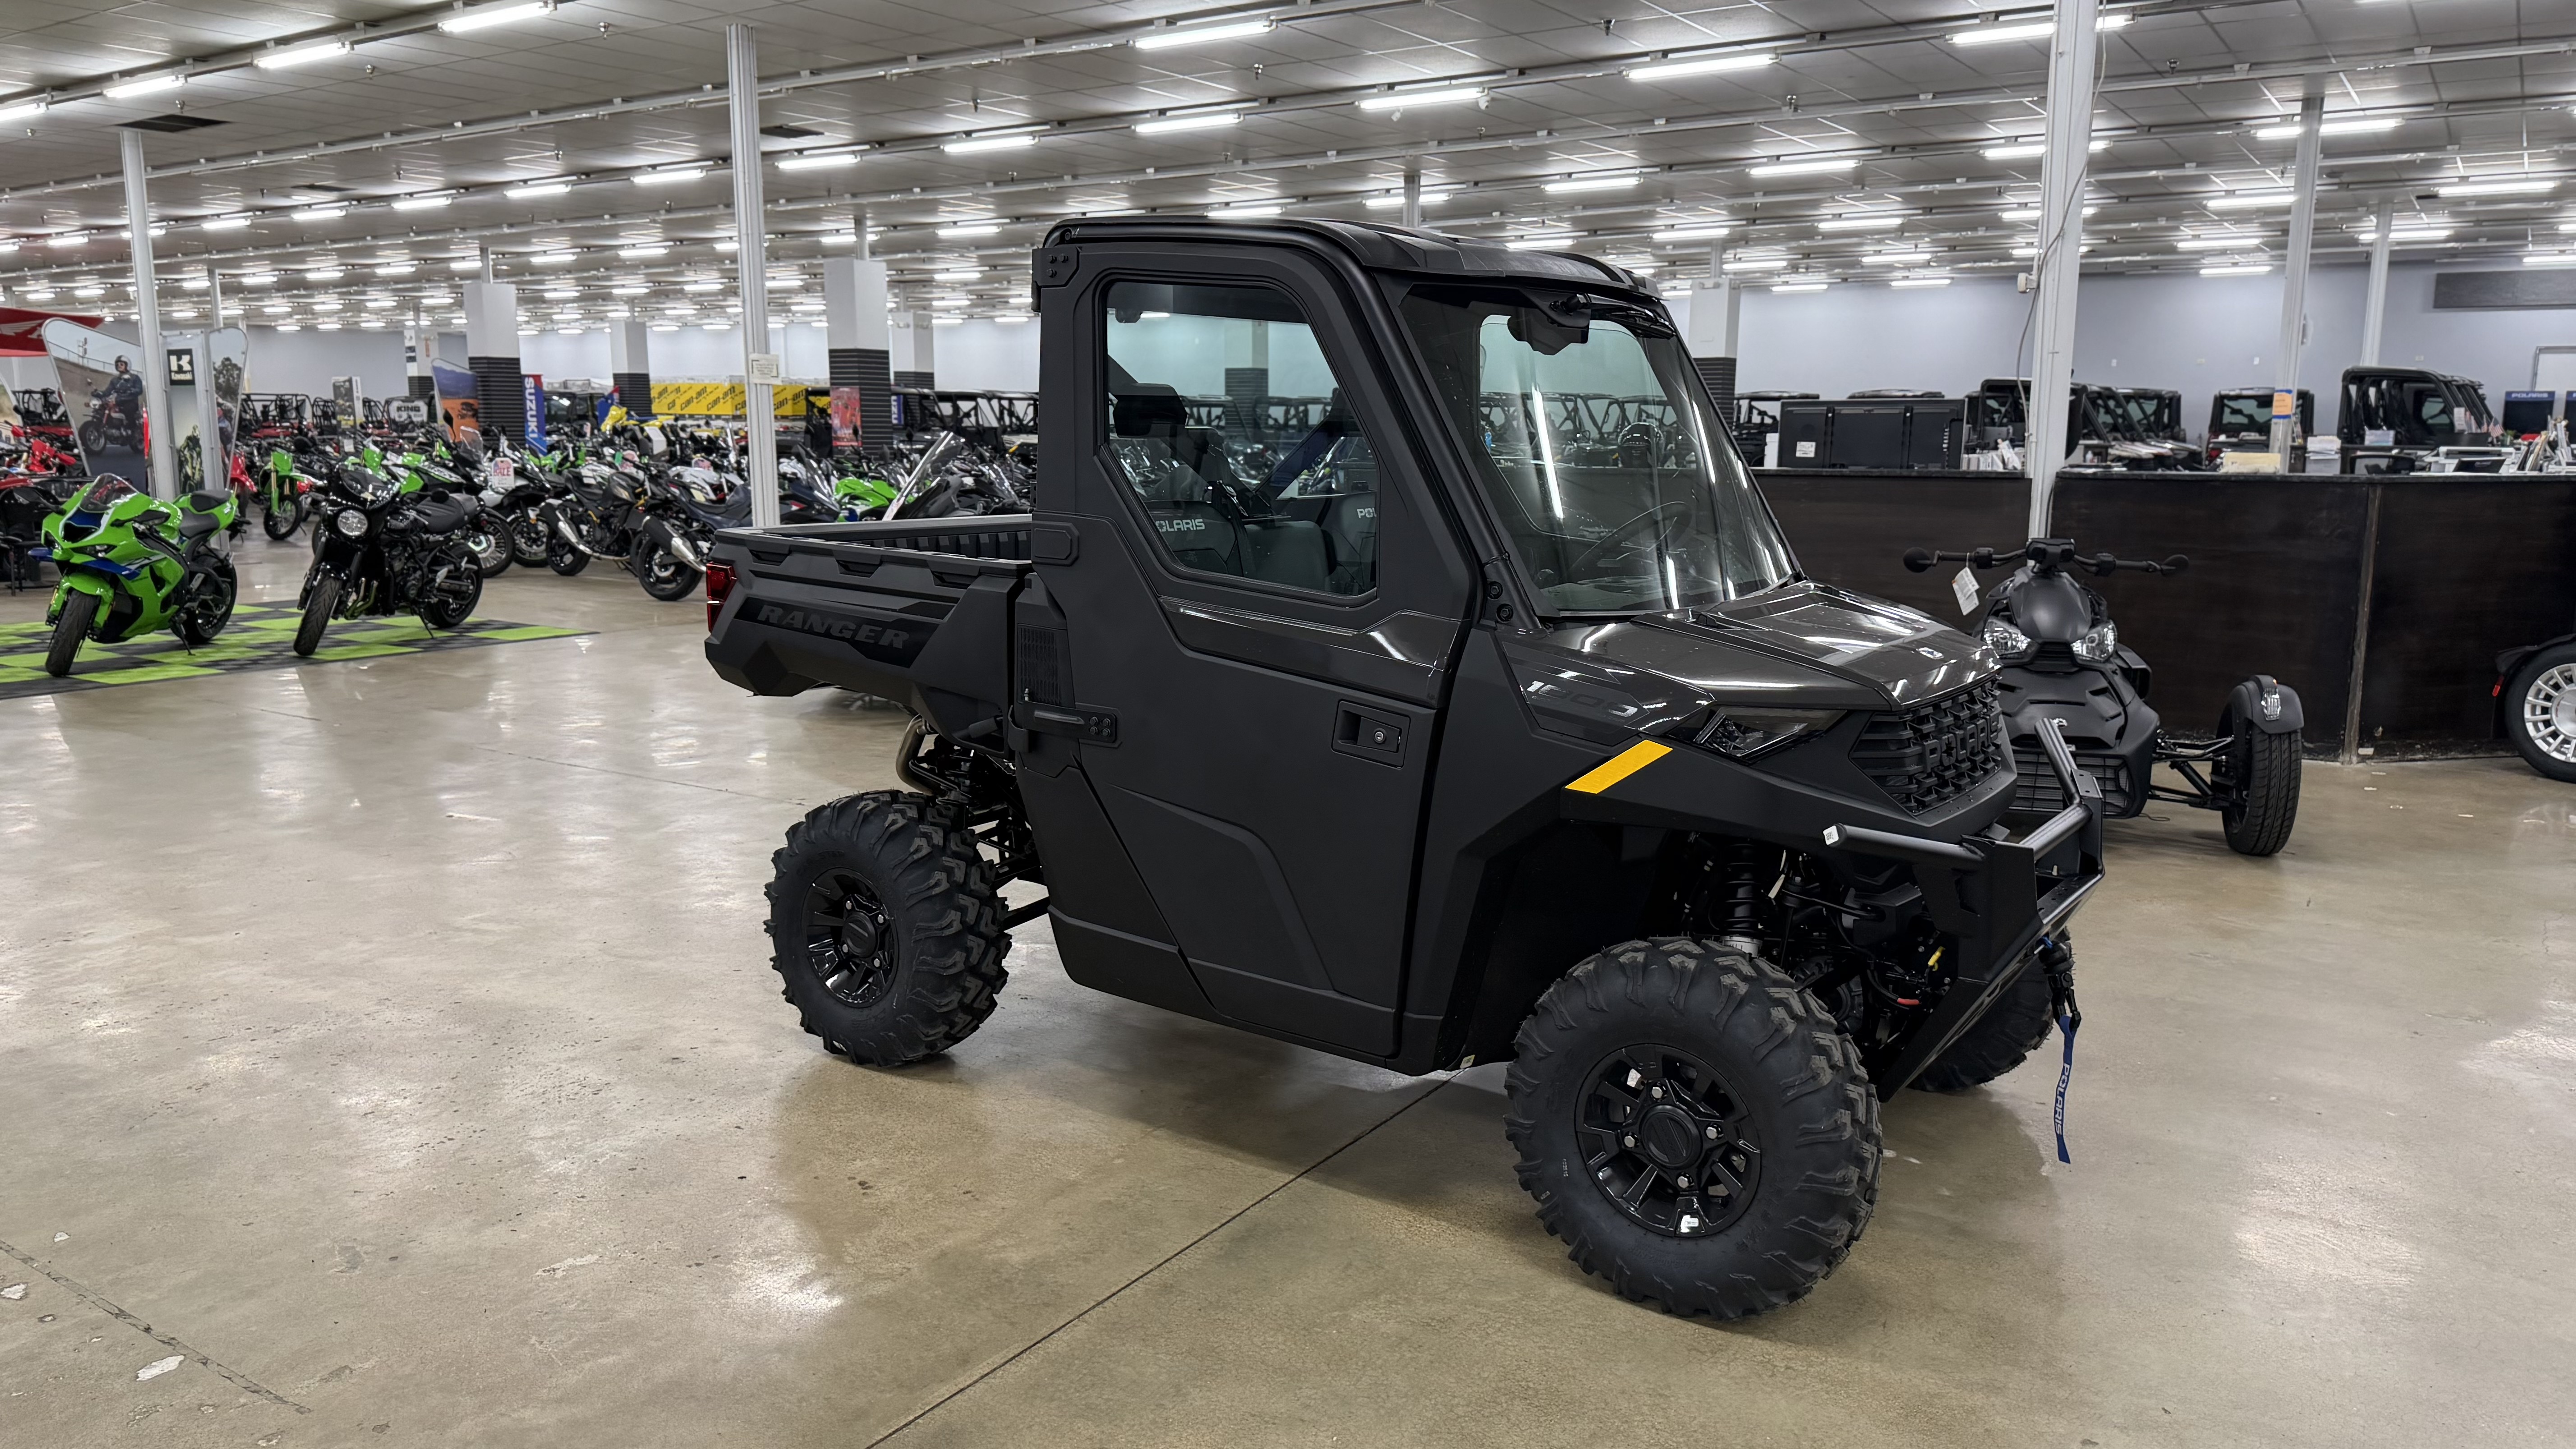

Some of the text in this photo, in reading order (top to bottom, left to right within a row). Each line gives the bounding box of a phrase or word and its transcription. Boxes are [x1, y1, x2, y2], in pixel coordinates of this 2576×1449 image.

[525, 377, 538, 438] SUZUKI
[681, 386, 707, 411] can-am
[707, 386, 736, 411] can-am
[1155, 519, 1205, 532] OLARIS
[1357, 507, 1377, 519] POL
[757, 604, 910, 649] RANGER
[1527, 680, 1638, 718] 1000
[1923, 710, 2001, 773] POLARIS
[2054, 1063, 2070, 1136] POLARIS
